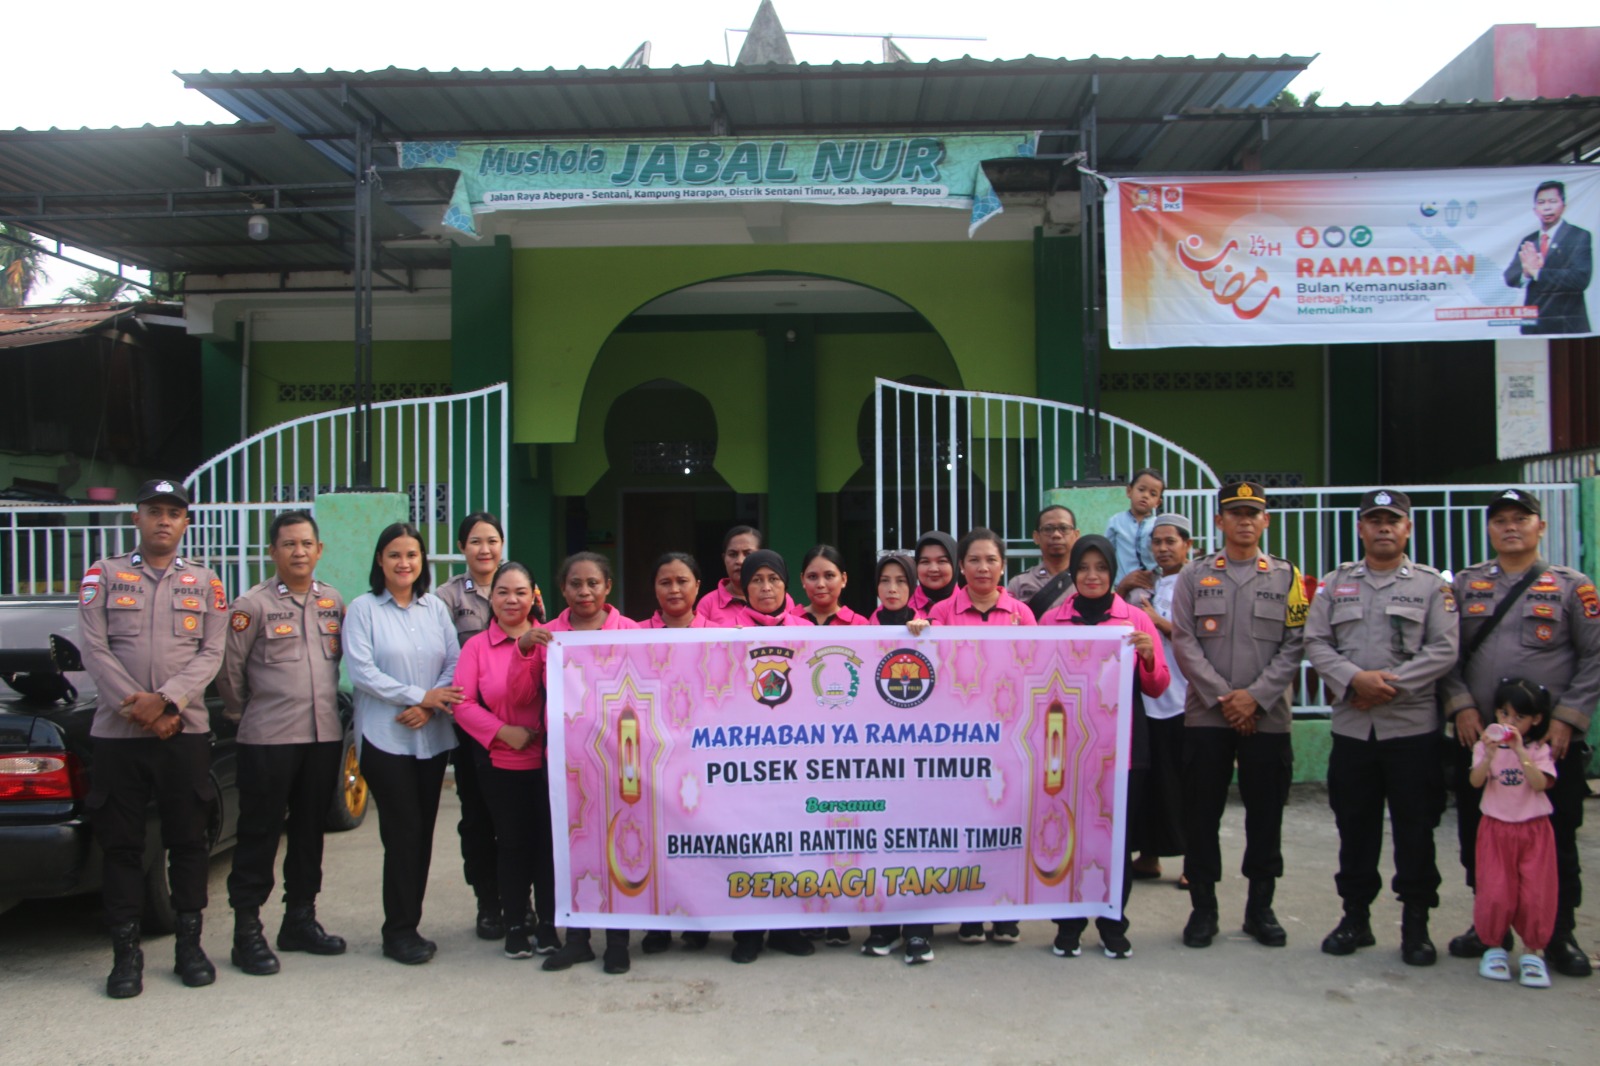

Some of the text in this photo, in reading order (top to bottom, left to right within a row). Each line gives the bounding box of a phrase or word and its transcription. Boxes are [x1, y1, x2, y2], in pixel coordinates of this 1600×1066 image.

[479, 138, 946, 185] Mushola JABAL NUR
[490, 193, 515, 202] Jalan
[517, 192, 541, 202] Raya
[543, 190, 584, 202] Abepura
[592, 189, 632, 200] Sentani,
[634, 188, 681, 201] Kampung
[683, 187, 728, 199] Harapan,
[729, 186, 763, 196] Distrik
[765, 186, 803, 196] Sentani
[805, 186, 836, 197] Timur,
[838, 186, 860, 195] Kab.
[911, 186, 942, 197] Papua
[1296, 255, 1475, 278] RAMADHAN
[1297, 280, 1447, 294] Bulan Kemanusiaan
[1297, 305, 1373, 315] Memulihkan
[173, 587, 205, 596] POLRI
[1526, 594, 1562, 602] POLRI
[1391, 596, 1424, 604] POLRI
[753, 648, 791, 658] PAPUA
[691, 722, 1001, 749] MARHABAN YA RAMADHAN
[707, 757, 992, 784] POLSEK SENTANI TIMUR
[805, 797, 886, 814] Bersama
[667, 826, 1023, 856] BHAYANGKARI RANTING SENTANI TIMUR
[727, 865, 986, 898] BERBAGI TAKJIL
